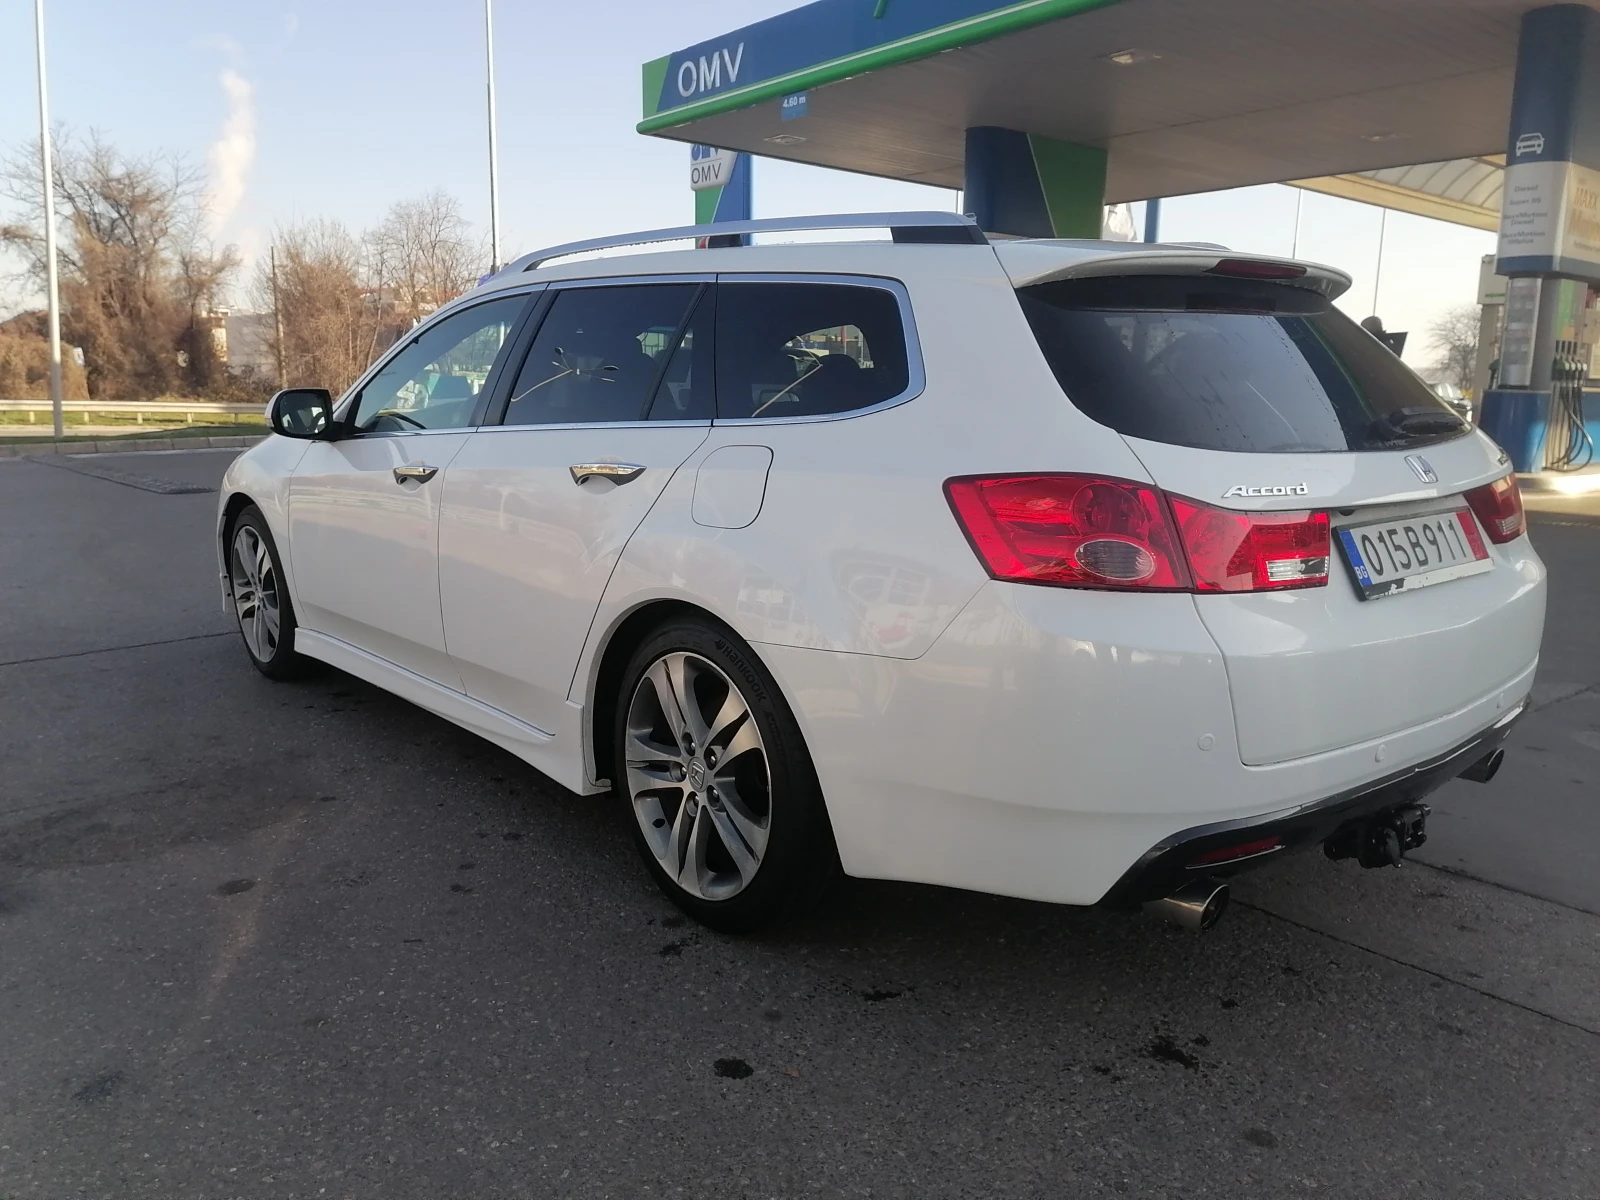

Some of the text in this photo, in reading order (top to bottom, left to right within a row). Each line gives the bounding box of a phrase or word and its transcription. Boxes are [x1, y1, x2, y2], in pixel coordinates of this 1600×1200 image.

[677, 42, 745, 98] OMV
[783, 96, 806, 108] 4.60 m
[691, 162, 722, 184] OMV
[1221, 482, 1309, 498] Accord
[1361, 519, 1467, 576] 015B911
[1354, 565, 1368, 580] BG
